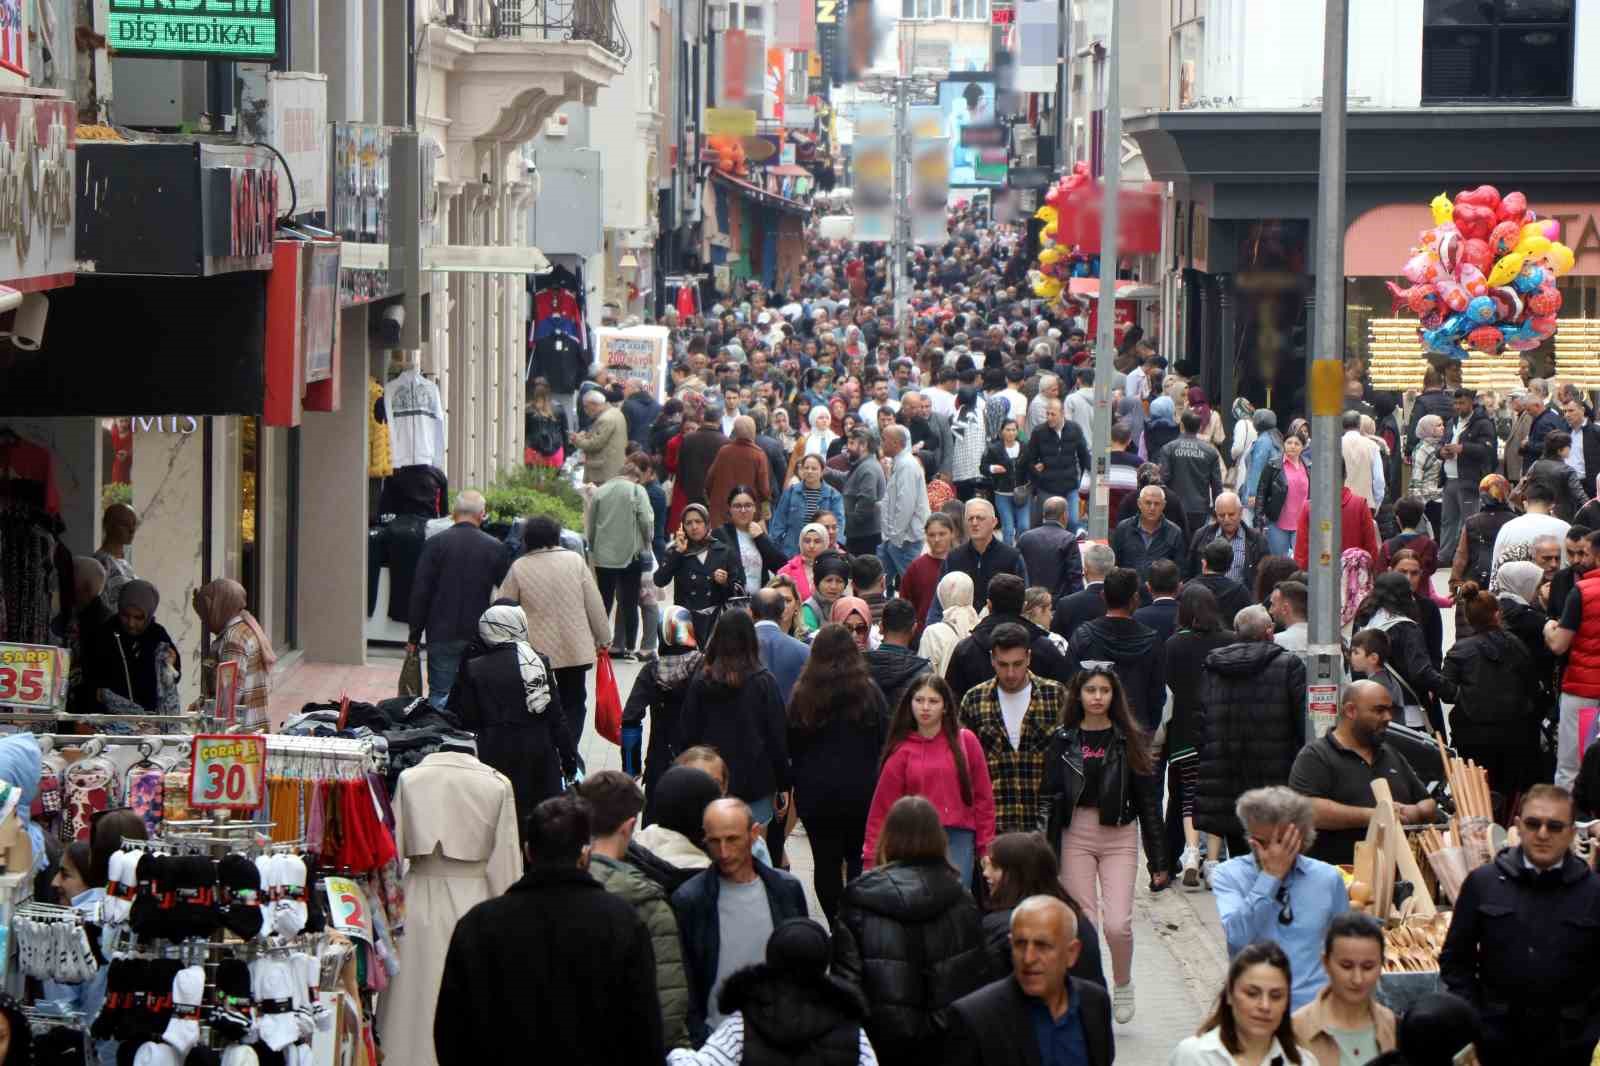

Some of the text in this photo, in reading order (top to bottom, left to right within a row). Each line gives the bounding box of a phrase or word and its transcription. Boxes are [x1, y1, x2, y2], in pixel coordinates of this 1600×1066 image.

[119, 15, 265, 47] DİŞ MEDİKAL
[0, 667, 44, 701] 35
[203, 764, 245, 800] 30
[340, 894, 368, 928] 2
